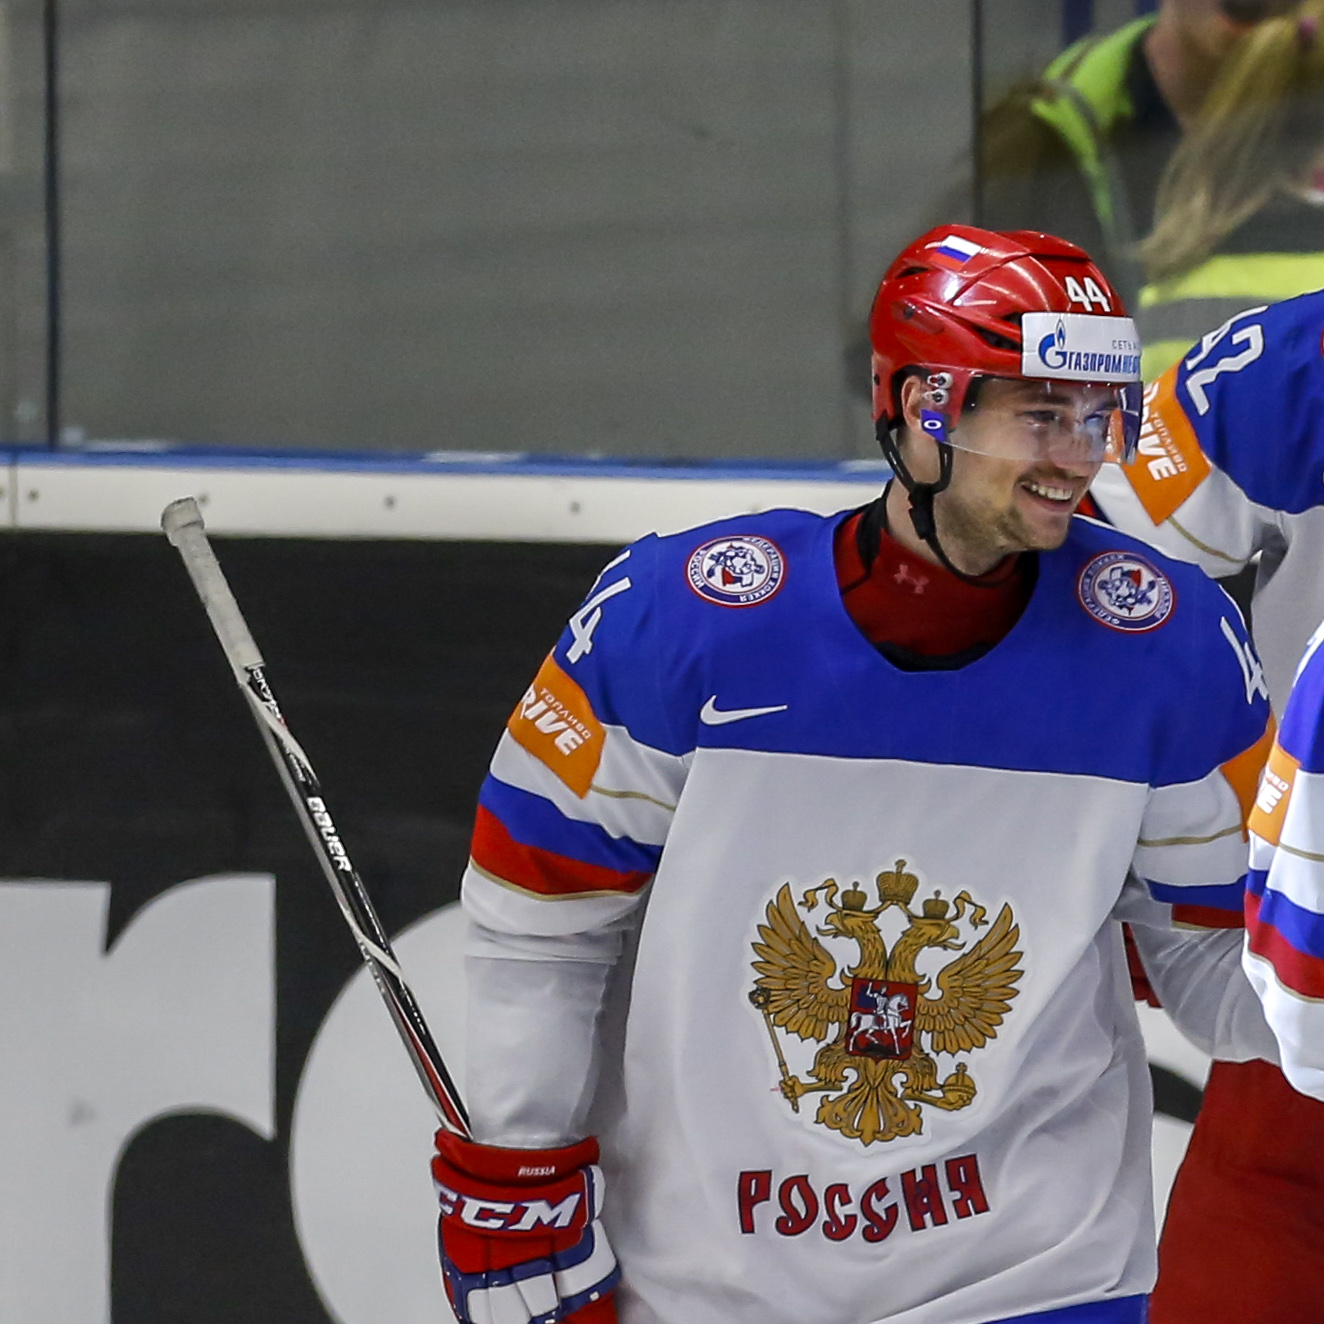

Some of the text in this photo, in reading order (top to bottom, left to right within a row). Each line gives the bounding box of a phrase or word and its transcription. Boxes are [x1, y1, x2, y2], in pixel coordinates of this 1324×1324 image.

[1064, 276, 1111, 312] 44
[539, 687, 593, 740] ТОПЛИВО
[517, 1165, 556, 1178] RUSSIA
[435, 1184, 582, 1231] CCM
[736, 1153, 991, 1243] РОССИЯ
